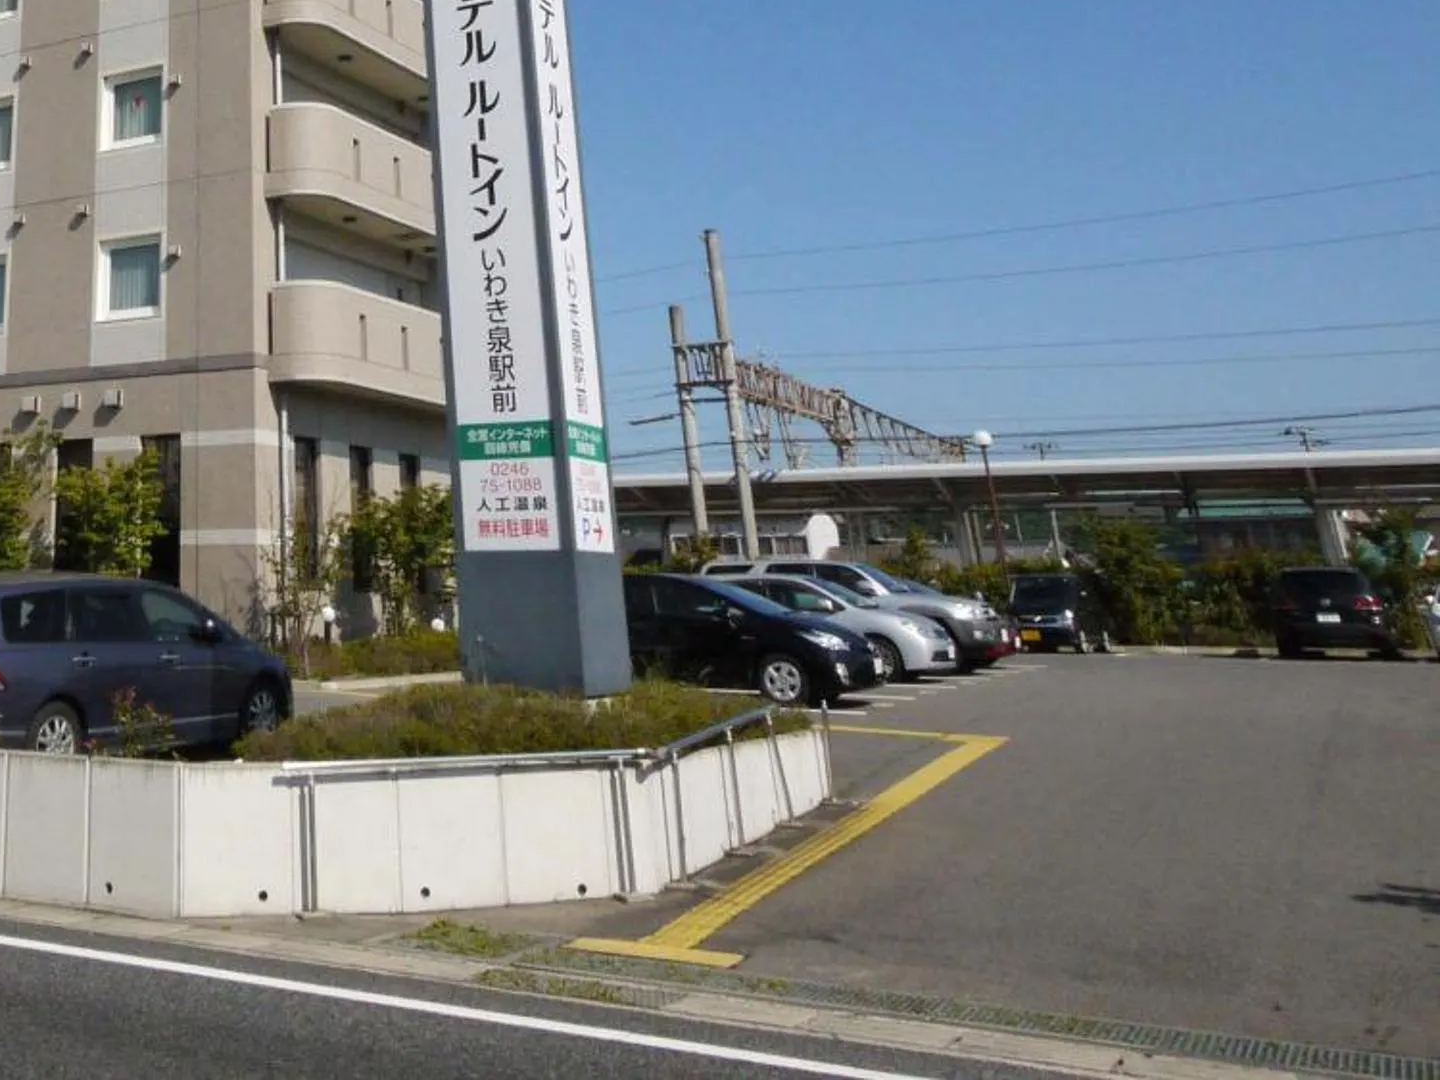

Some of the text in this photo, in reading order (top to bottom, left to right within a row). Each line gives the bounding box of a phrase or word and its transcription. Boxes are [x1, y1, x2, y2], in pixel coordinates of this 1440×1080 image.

[464, 80, 508, 241] ルートイン
[548, 84, 573, 241] ルートイン
[481, 248, 518, 413] いわき泉駅前
[477, 496, 549, 512] 人工温泉
[490, 463, 529, 476] 0246
